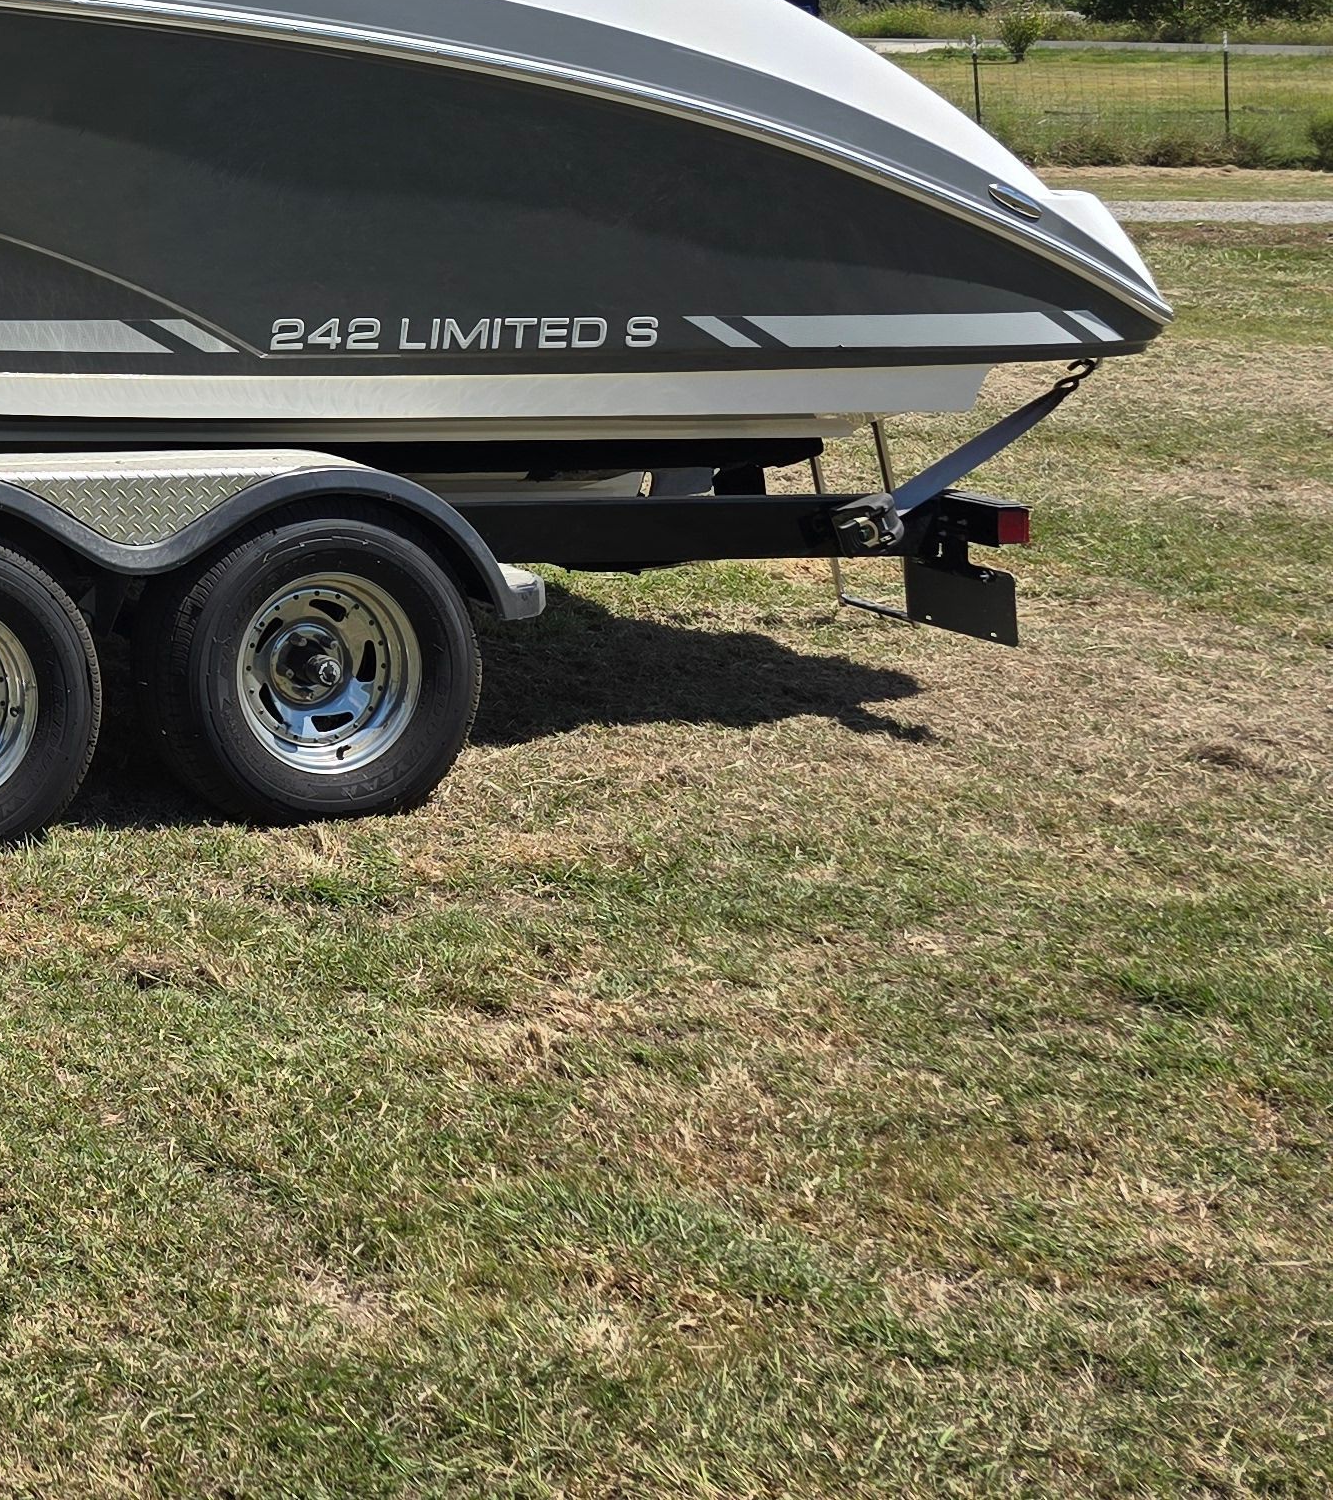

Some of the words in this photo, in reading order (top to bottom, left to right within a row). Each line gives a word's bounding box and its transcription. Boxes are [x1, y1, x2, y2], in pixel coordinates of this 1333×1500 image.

[270, 317, 381, 351] 242
[398, 316, 608, 350] LIMITED
[624, 316, 659, 349] S
